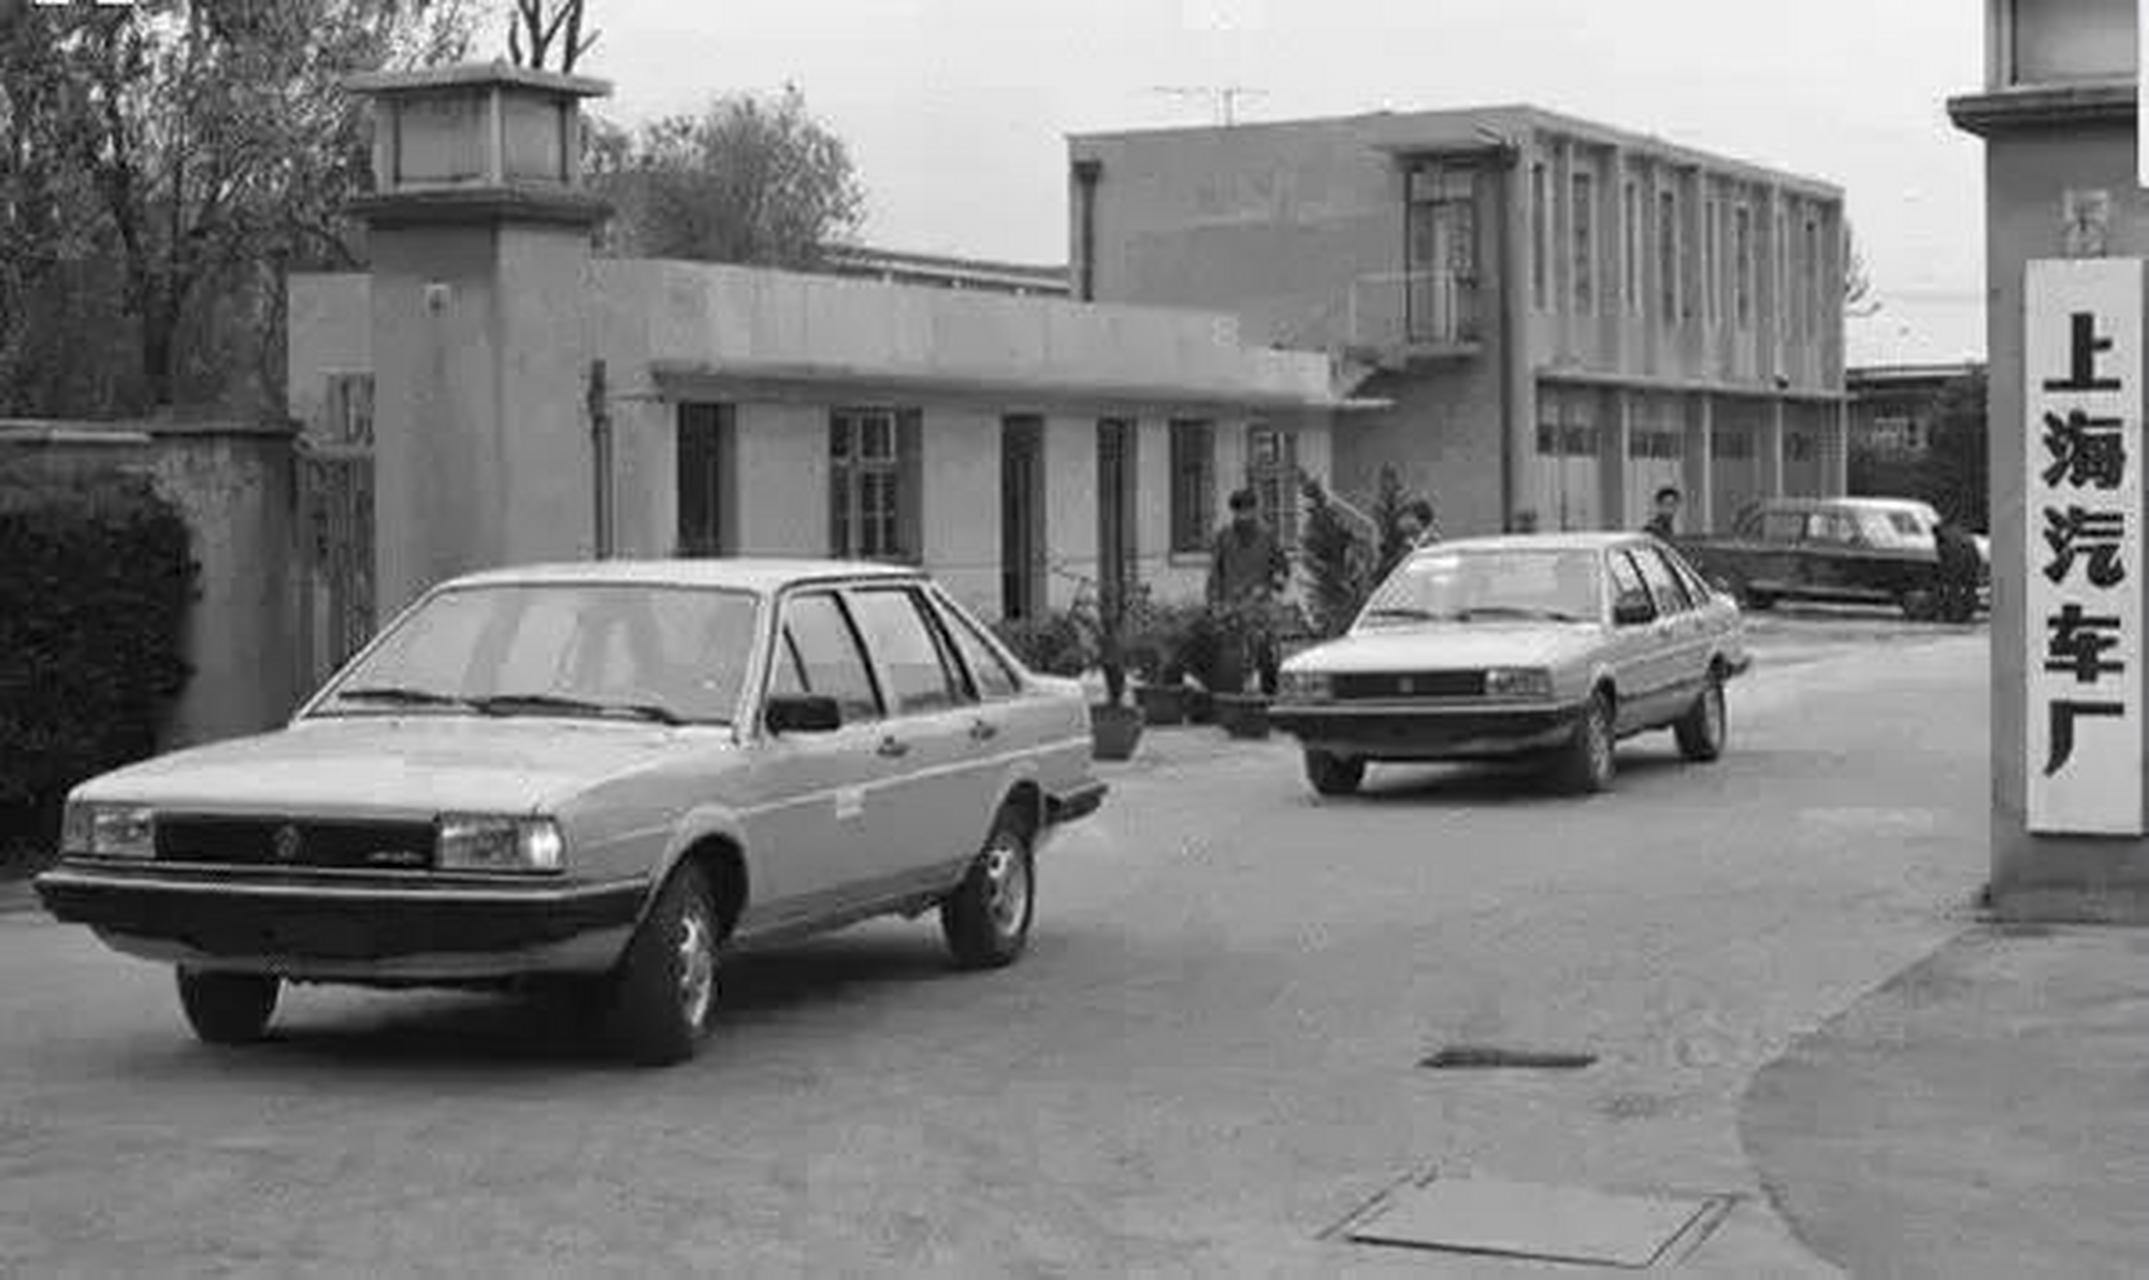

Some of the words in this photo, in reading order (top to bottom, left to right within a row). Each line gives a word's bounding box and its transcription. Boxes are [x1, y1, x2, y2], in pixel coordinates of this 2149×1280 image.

[2042, 312, 2126, 776] 上海汽车厂
